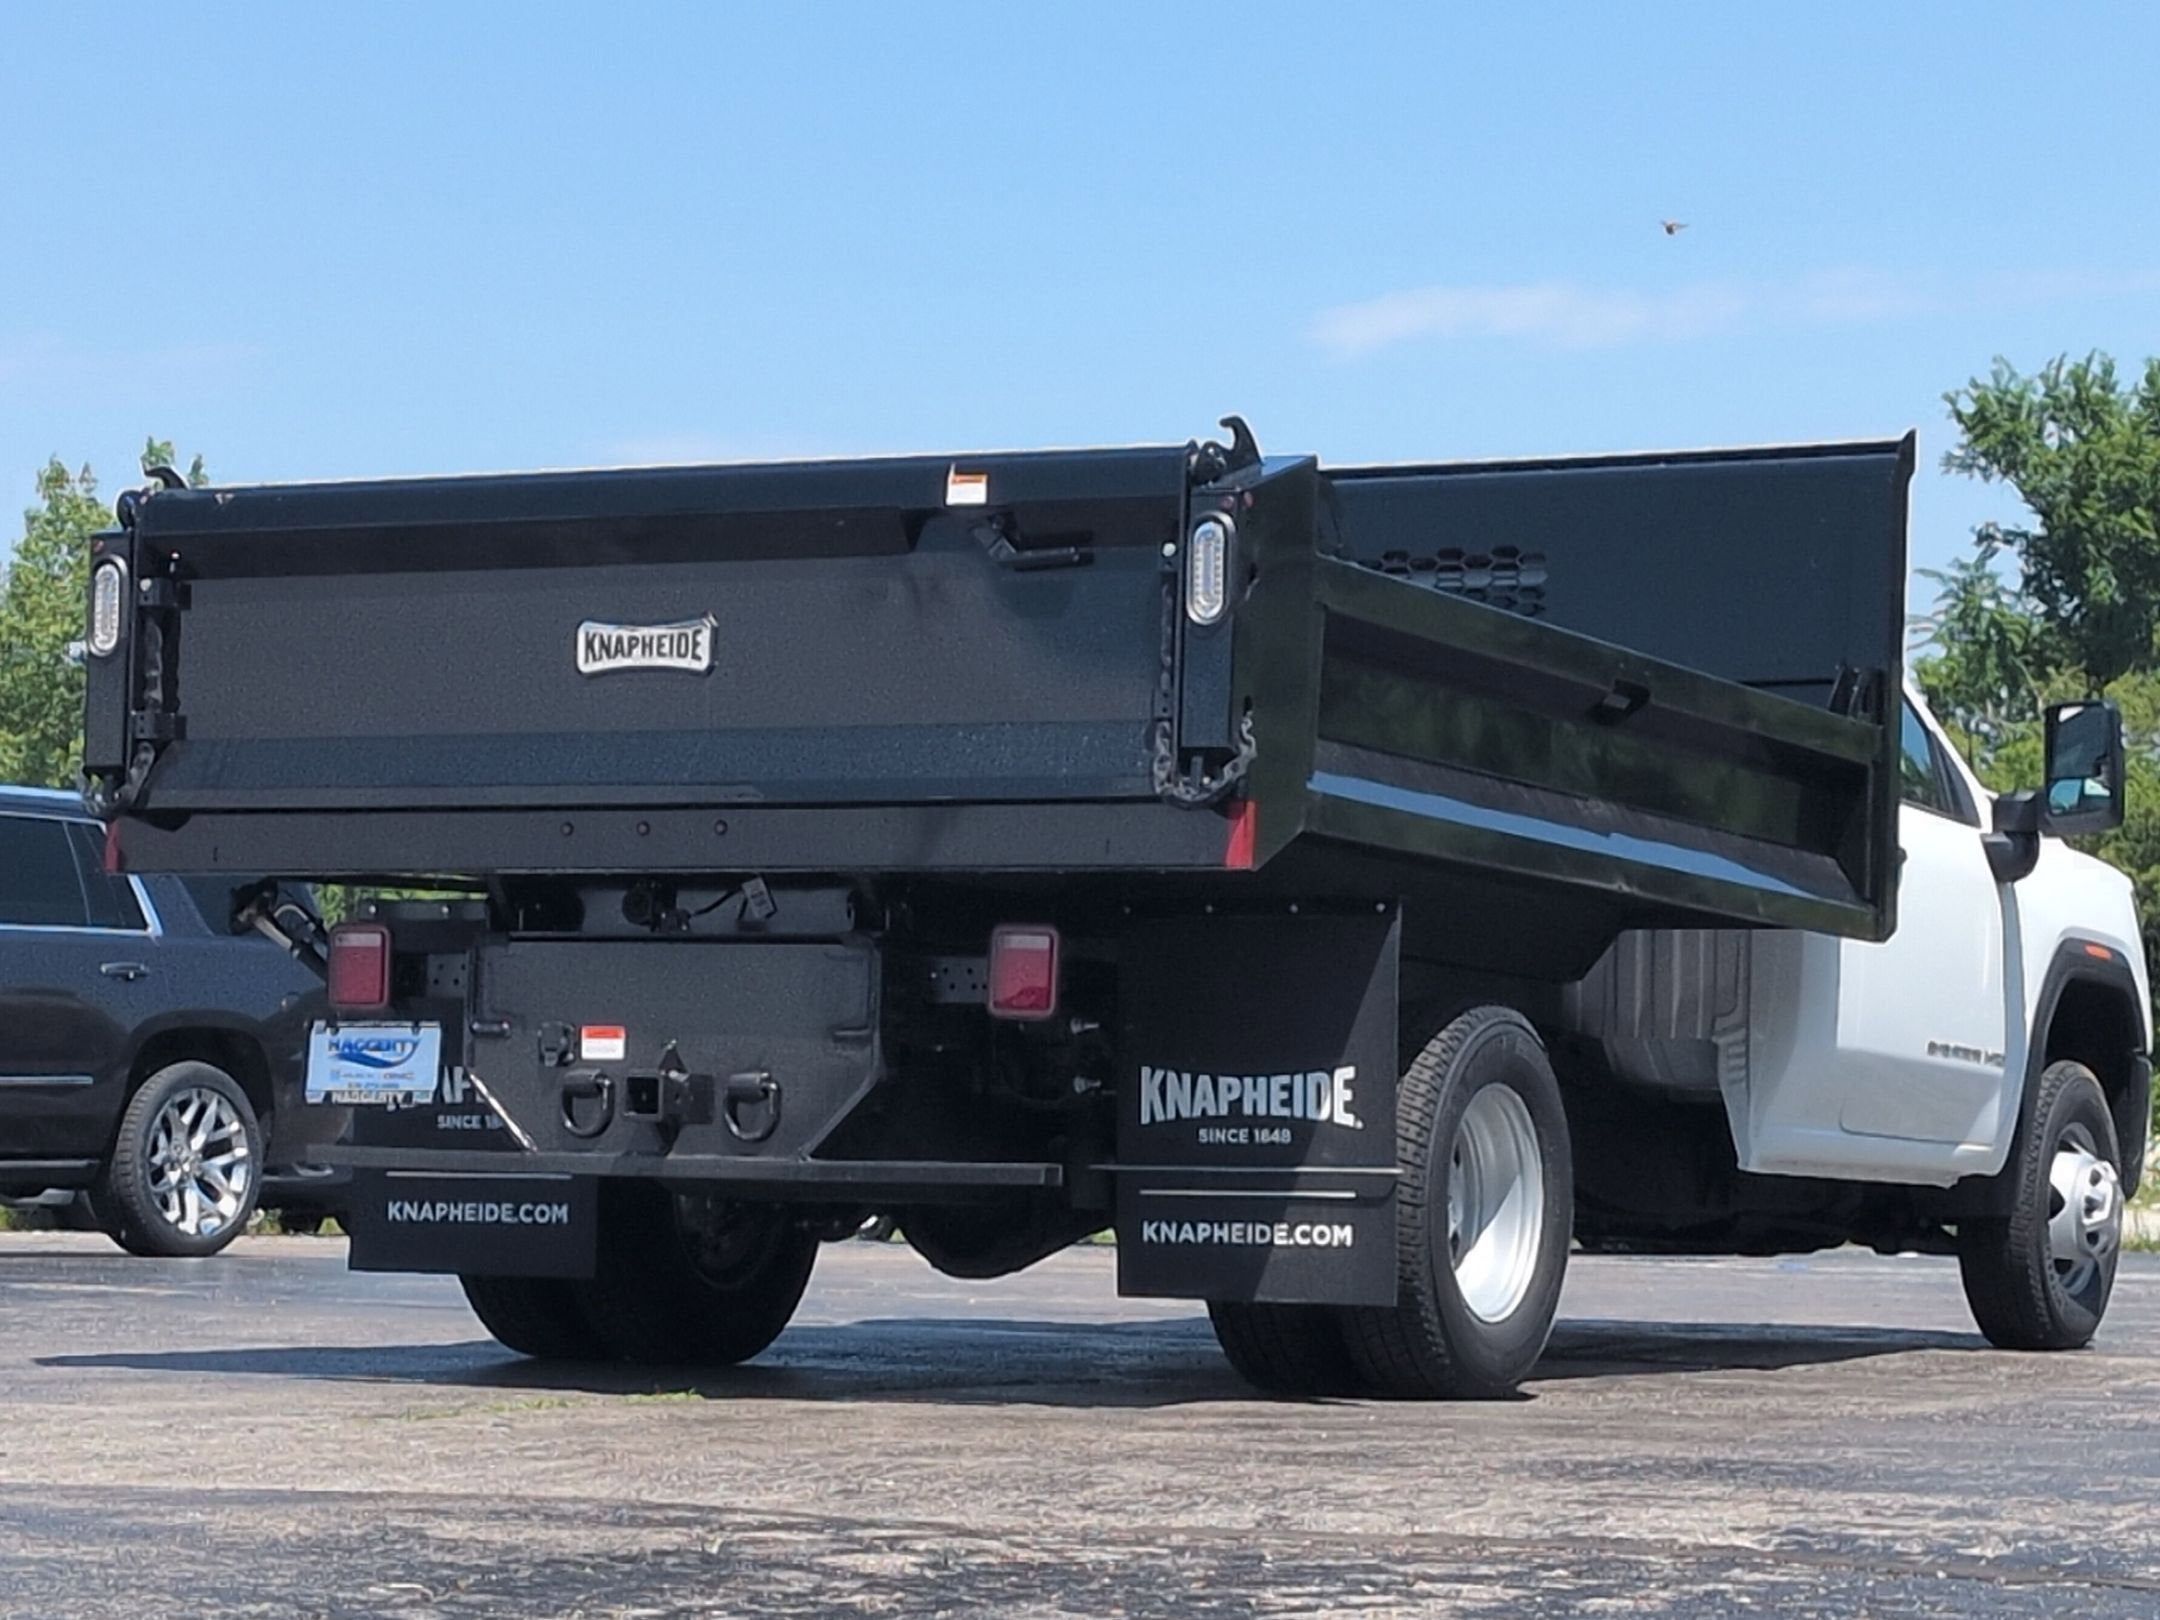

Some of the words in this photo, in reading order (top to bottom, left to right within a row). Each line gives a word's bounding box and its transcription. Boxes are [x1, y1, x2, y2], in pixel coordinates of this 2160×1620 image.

[585, 628, 702, 663] KNAPHEIDE
[1140, 1066, 1358, 1128] KNAPHEIDE
[437, 1114, 482, 1129] SINCE
[1198, 1128, 1249, 1143] SINCE
[1254, 1128, 1292, 1143] 1848
[388, 1202, 569, 1224] KNAPHEIDE.COM
[1142, 1220, 1353, 1247] KNAPHEIDE.COM
